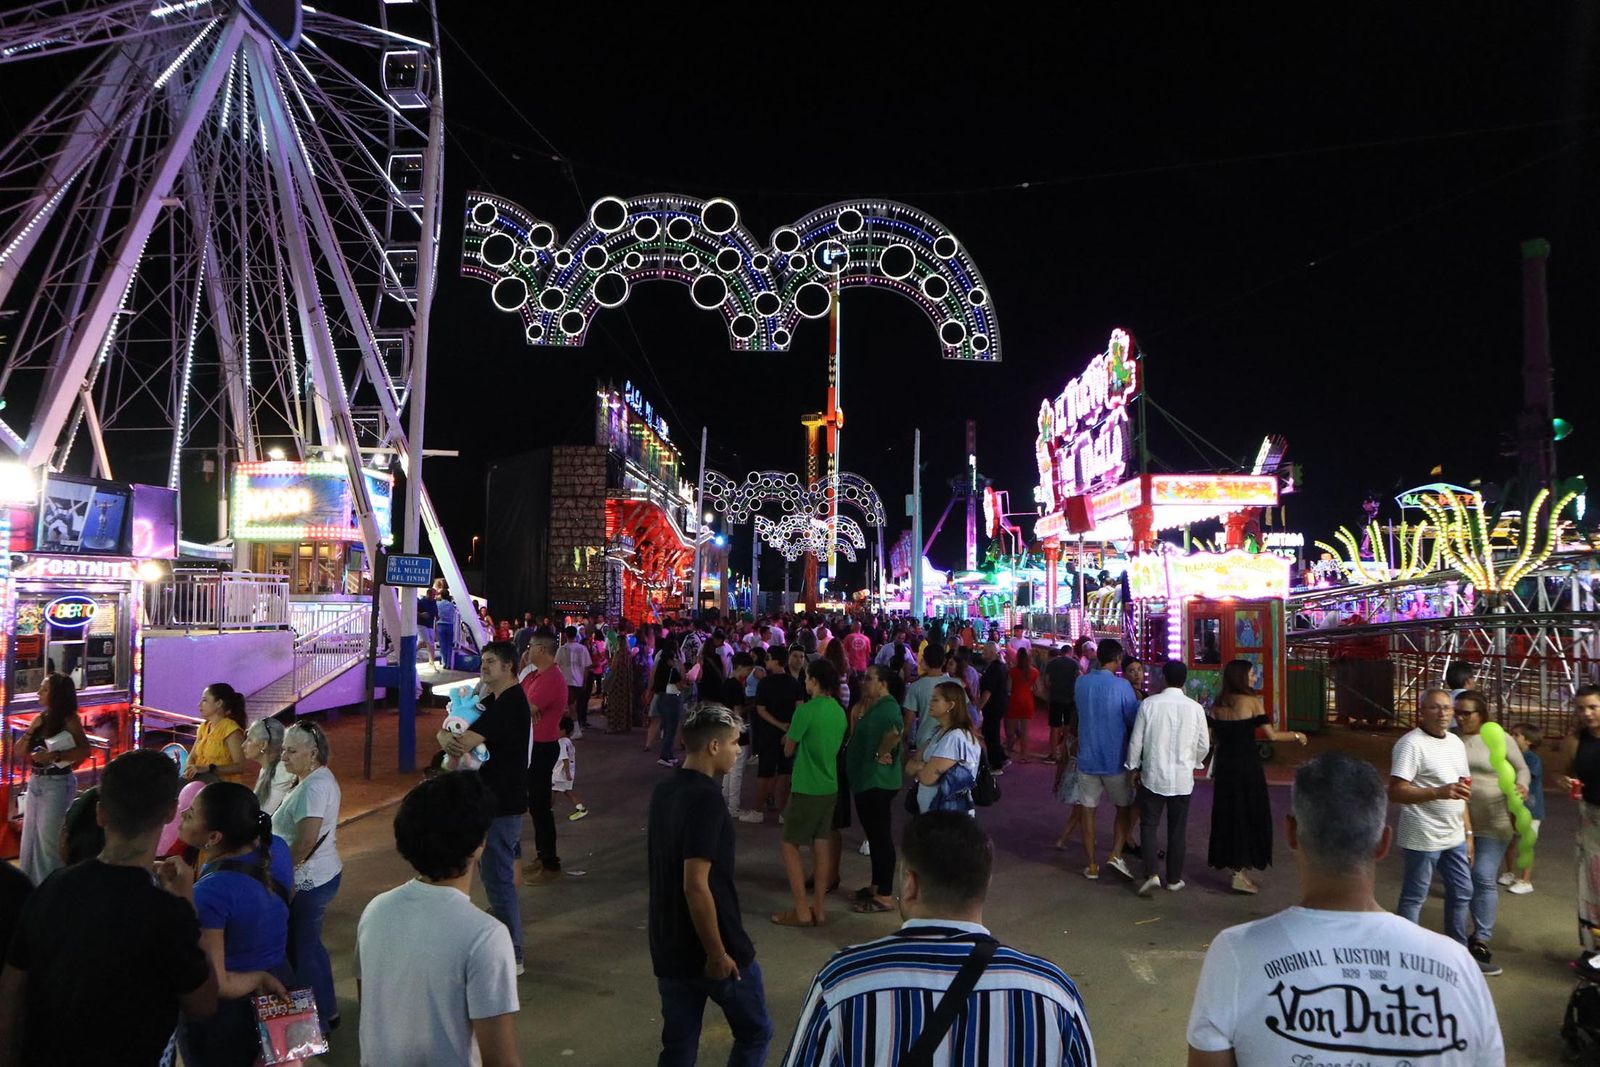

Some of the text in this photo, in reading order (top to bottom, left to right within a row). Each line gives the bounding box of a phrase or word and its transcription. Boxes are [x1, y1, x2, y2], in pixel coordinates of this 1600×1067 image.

[35, 558, 132, 577] FORTNITE
[389, 566, 429, 575] DEL MUELLE
[1264, 947, 1460, 989] ORIGINAL KUSTOM KULTURE
[1266, 980, 1461, 1048] Von Dutch
